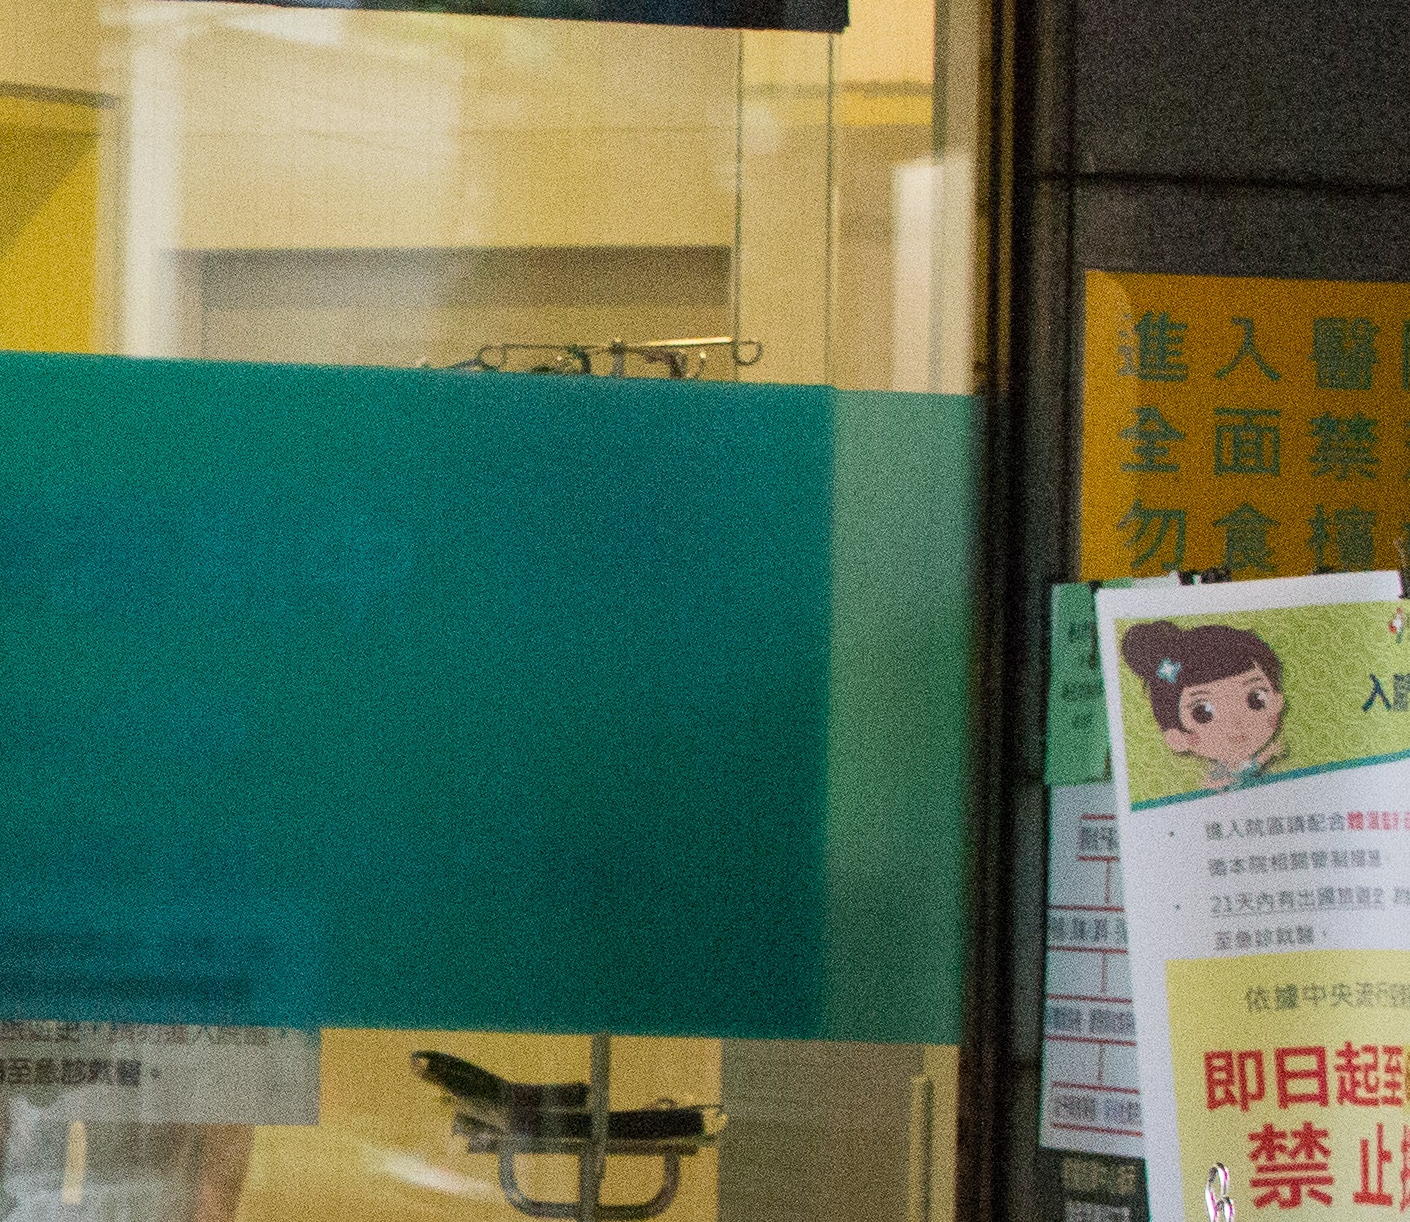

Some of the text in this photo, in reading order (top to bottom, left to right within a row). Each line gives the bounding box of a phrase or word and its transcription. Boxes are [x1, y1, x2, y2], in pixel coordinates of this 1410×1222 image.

[1117, 310, 1410, 391] 進入醫
[1117, 405, 1410, 481] 全面禁
[1247, 1121, 1410, 1213] 禁止
